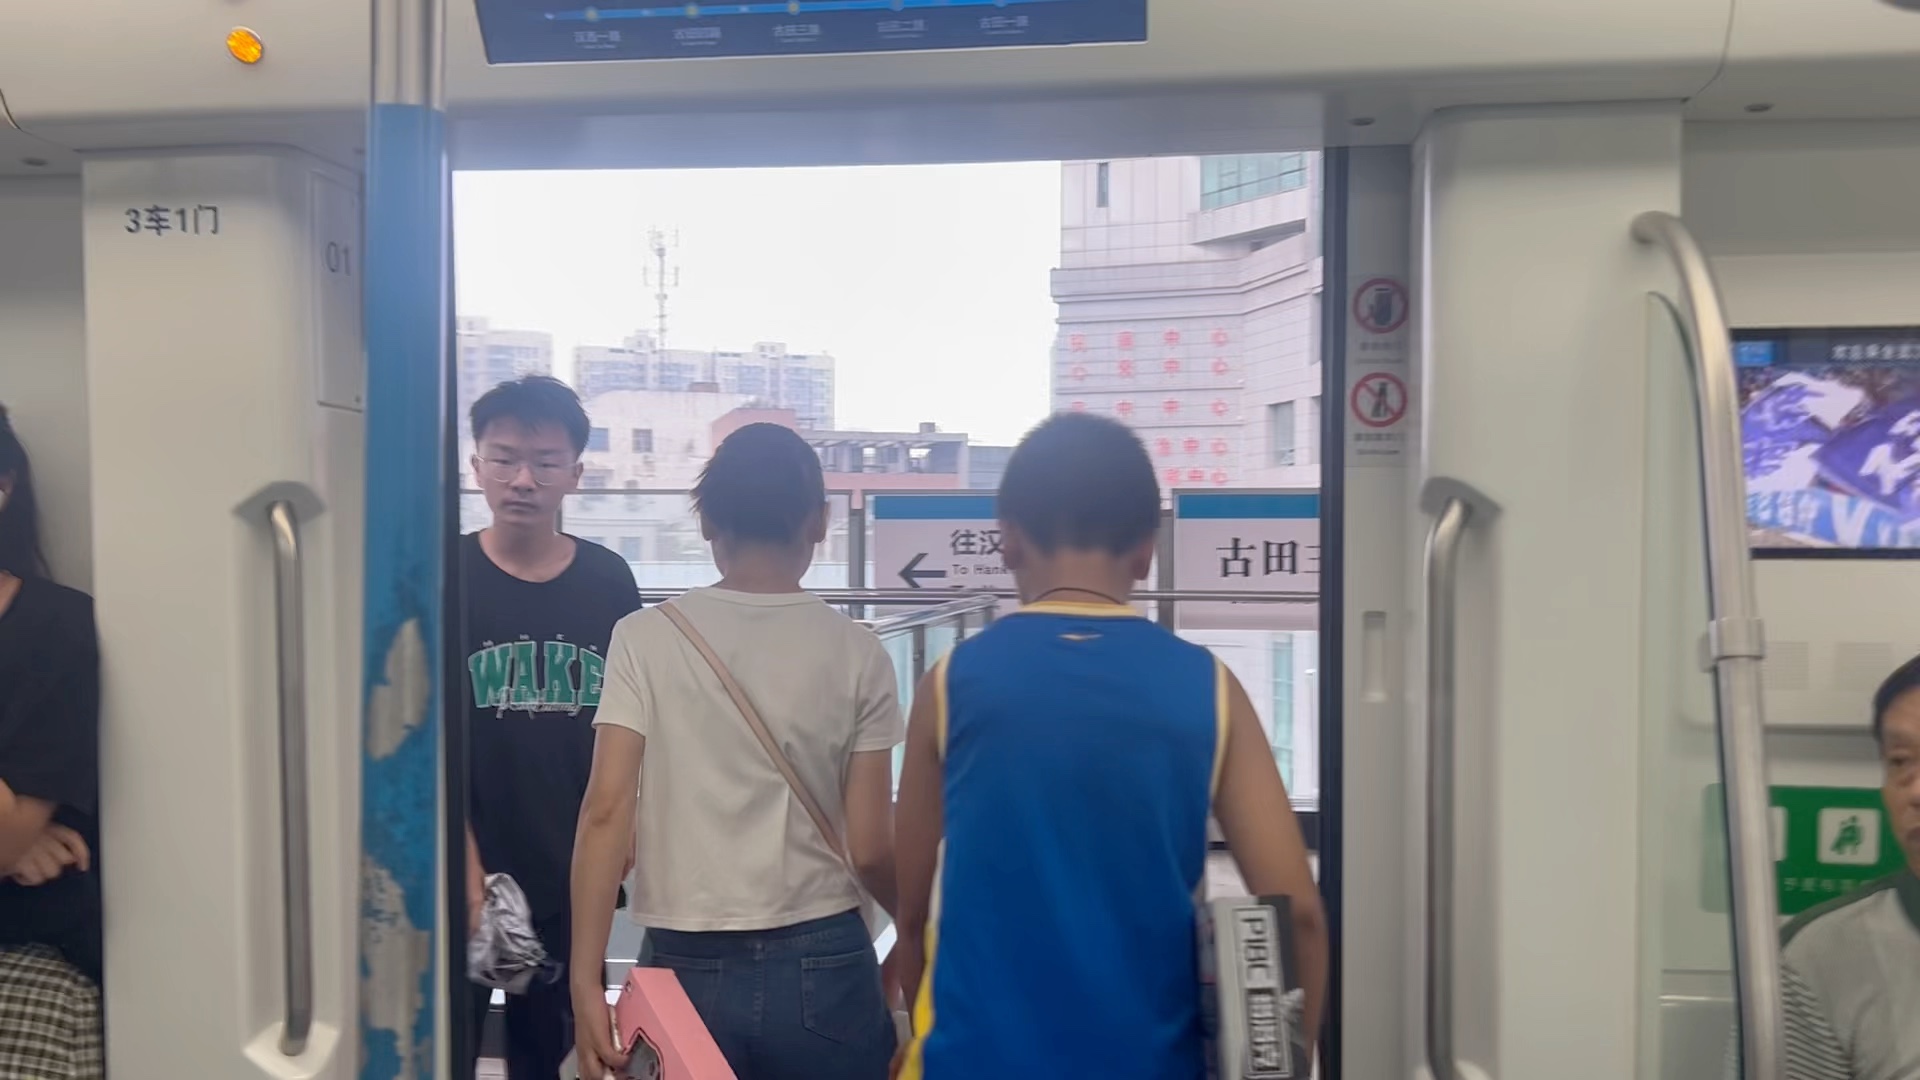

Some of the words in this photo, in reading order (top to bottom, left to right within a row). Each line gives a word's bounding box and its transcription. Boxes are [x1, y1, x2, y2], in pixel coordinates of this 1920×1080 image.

[124, 204, 219, 235] 3车1门
[326, 241, 351, 276] 01
[950, 529, 1004, 555] 往汉
[952, 564, 968, 575] To
[468, 641, 605, 708] WAKE
